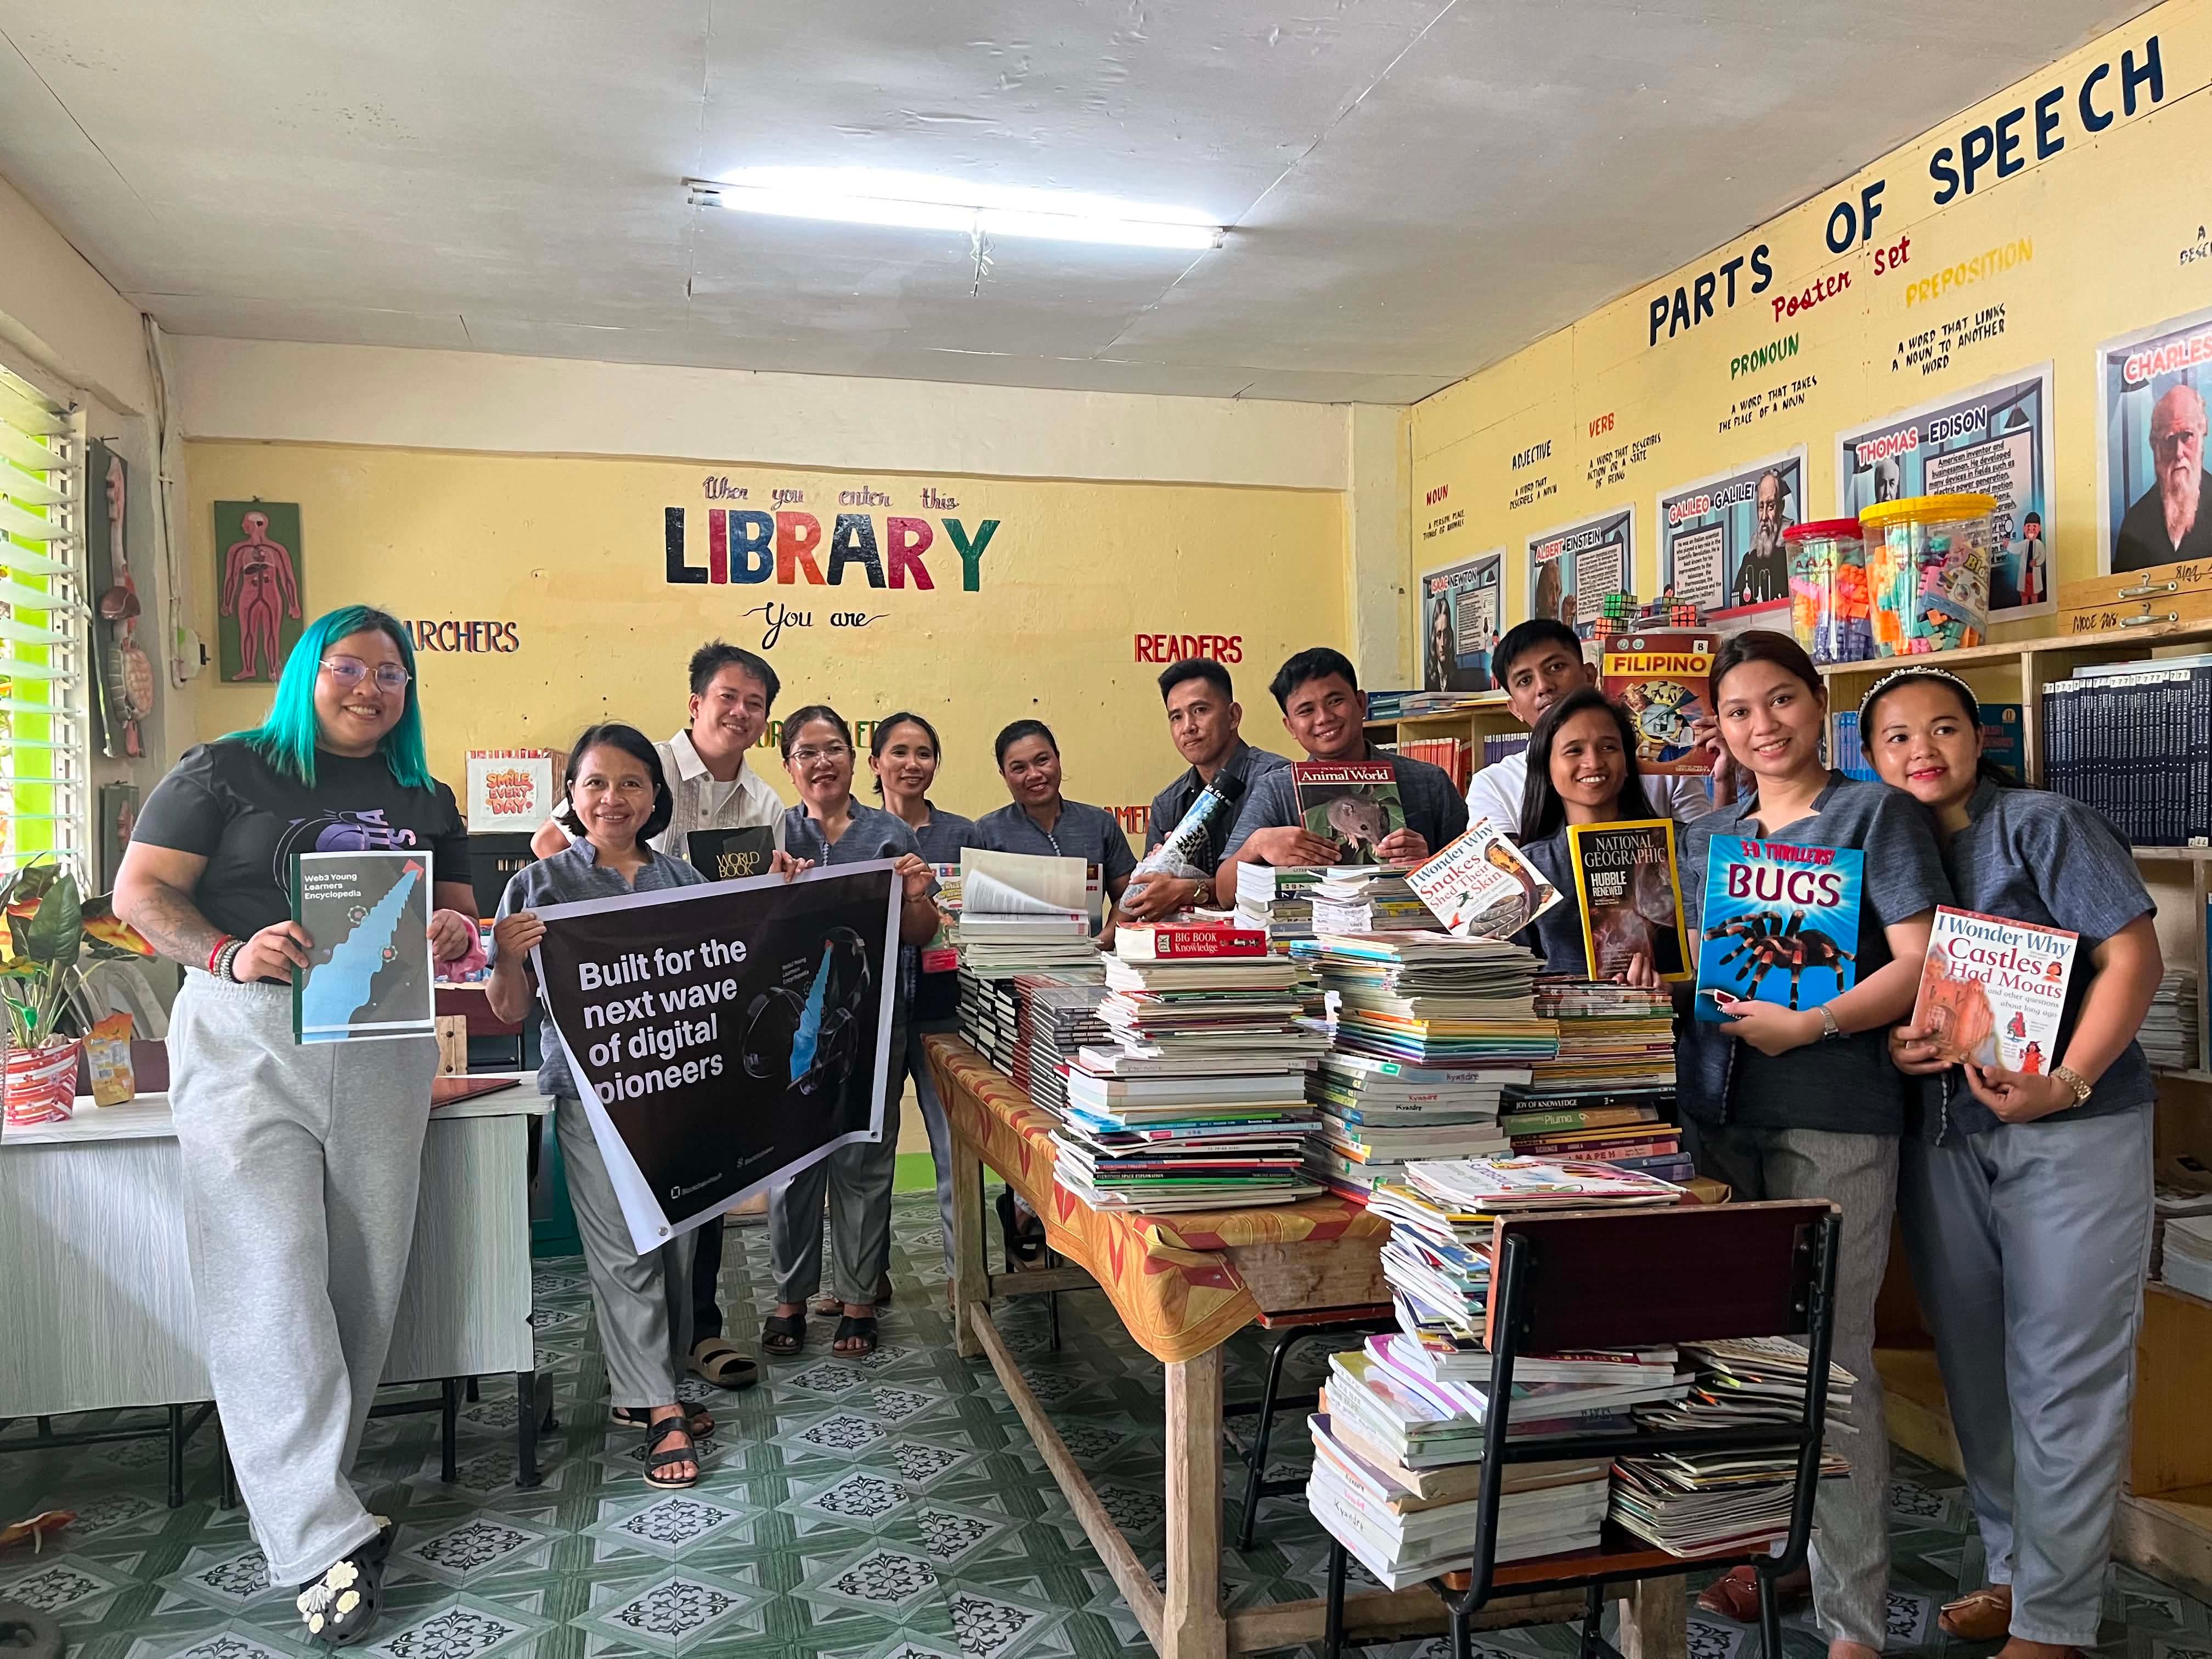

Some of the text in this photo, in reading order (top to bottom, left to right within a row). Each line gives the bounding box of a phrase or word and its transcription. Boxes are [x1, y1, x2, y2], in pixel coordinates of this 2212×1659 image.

[1650, 35, 2165, 347] PARTS OF SPEECH
[2197, 225, 2205, 241] A
[1771, 235, 1910, 323] Poster Set
[1905, 237, 2033, 307] PREPOSITION
[1898, 302, 2006, 355] A WORD THAT LINKS
[1731, 331, 1799, 381] PRONOUN
[1892, 318, 2005, 373] A NOUN TO ANOTHER
[1922, 354, 1949, 376] WORD
[2125, 335, 2212, 381] CHARLES
[1731, 375, 1817, 415] A WORD THAT TAKES
[1589, 412, 1615, 438] VERB
[1719, 393, 1805, 433] THE PLACE OF A NOUN
[1857, 408, 1987, 464] THOMAS EDISON
[1512, 439, 1551, 471] ADJECTIVE
[1596, 452, 1613, 465] WORD
[1615, 445, 1628, 458] THAT
[1938, 440, 2004, 466] American inventor and
[1980, 448, 2011, 464] developed
[1587, 466, 1606, 482] ACTION
[1610, 460, 1618, 472] OR
[1630, 449, 1646, 464] STATE
[1520, 481, 1534, 495] WORD
[1536, 477, 1547, 490] THAT
[1543, 483, 1557, 496] NOUN
[1929, 478, 1944, 489] many
[1945, 473, 1966, 483] devices
[1992, 481, 2013, 492] motion
[703, 476, 748, 500] When
[768, 488, 805, 511] you
[838, 485, 894, 507] enter
[1426, 484, 1448, 506] NOUN
[1669, 483, 1754, 522] GALILEO GALILEI
[665, 507, 1001, 592] LIBRARY
[1536, 529, 1600, 561] ALBERT EINSTEIN
[1431, 568, 1477, 592] ISAAC NEWTON
[403, 620, 520, 653] ARCHERS
[738, 602, 890, 650] You are
[1135, 634, 1243, 664] READERS
[1698, 643, 1704, 651] 8
[1614, 656, 1707, 672] FILIPINO
[1301, 769, 1389, 781] Animal World
[489, 787, 527, 799] EVERY
[492, 798, 527, 814] DAY
[1595, 834, 1655, 851] NATIONAL
[716, 851, 760, 867] WORLD
[1410, 823, 1493, 888] I Wonder Why
[1584, 848, 1666, 868] GEOGRAPHIC
[304, 874, 329, 882] Web3
[719, 864, 755, 878] BOOK
[1420, 853, 1481, 900] Snakes
[1471, 871, 1503, 894] Skin
[1591, 871, 1627, 887] HUBBLE
[304, 883, 343, 891] Learners
[304, 889, 362, 900] Encyclopedia
[1430, 864, 1489, 910] Shed Their
[1593, 885, 1623, 896] RENEWED
[1729, 864, 1842, 908] BUGS
[1175, 933, 1217, 942] BIG BOOK
[1175, 942, 1219, 953] Knowledge
[1937, 915, 2071, 959] I Wonder Why
[579, 939, 747, 991] Built for the
[1948, 937, 2044, 975] Castles
[1948, 961, 2062, 999] Had Moats
[583, 978, 737, 1029] next wave
[2000, 999, 2022, 1011] about
[2024, 1004, 2040, 1016] long
[2004, 990, 2024, 1001] other
[589, 1013, 718, 1067] of digital
[594, 1053, 724, 1104] pioneers
[1516, 1101, 1526, 1110] JOY
[1538, 1099, 1578, 1107] KNOWLEDGE
[1544, 1114, 1572, 1126] Pluma
[1535, 1144, 1558, 1153] SCIENCE
[1575, 1150, 1616, 1160] MAPEH
